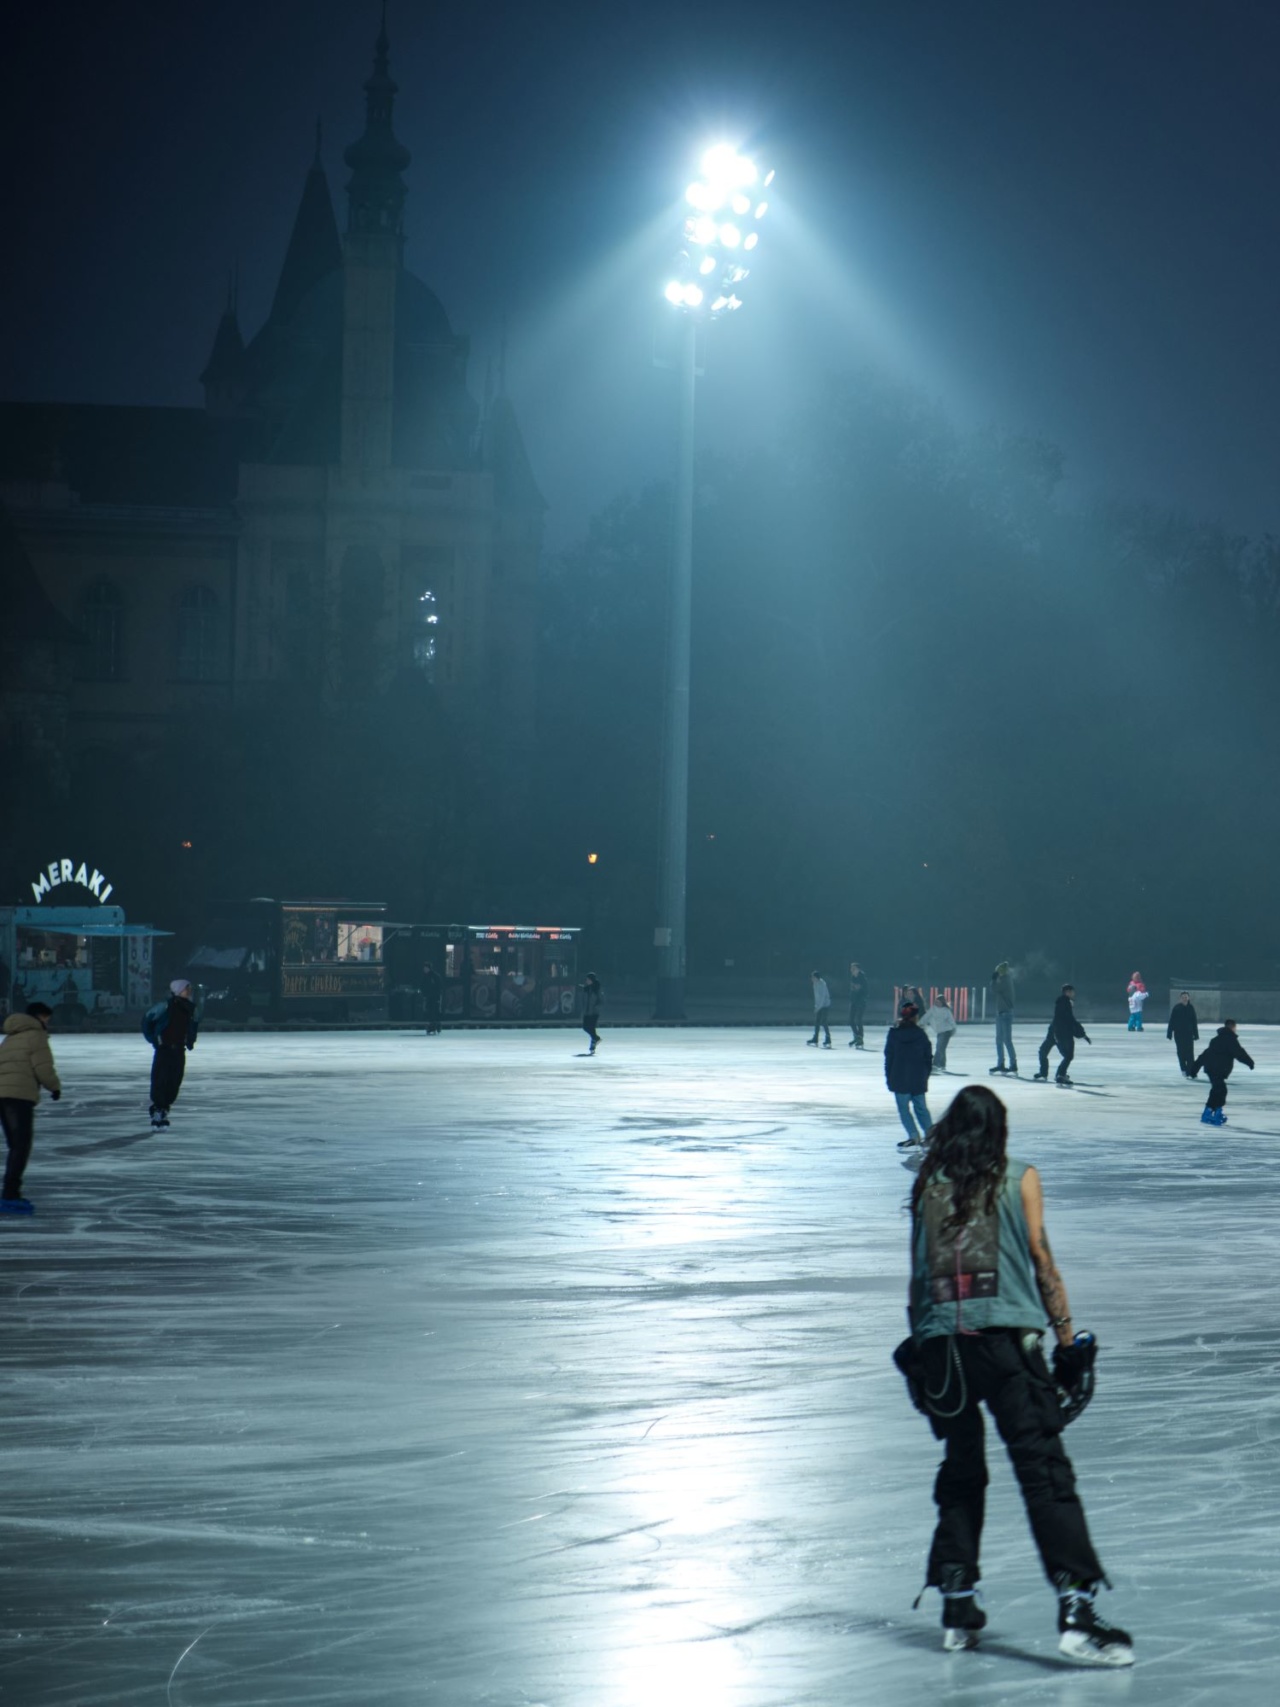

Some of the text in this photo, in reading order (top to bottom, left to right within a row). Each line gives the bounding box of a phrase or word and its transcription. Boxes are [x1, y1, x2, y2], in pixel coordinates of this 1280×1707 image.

[31, 858, 113, 904] MERAKI
[284, 975, 308, 993] HAPPY
[311, 973, 343, 993] CHURROS
